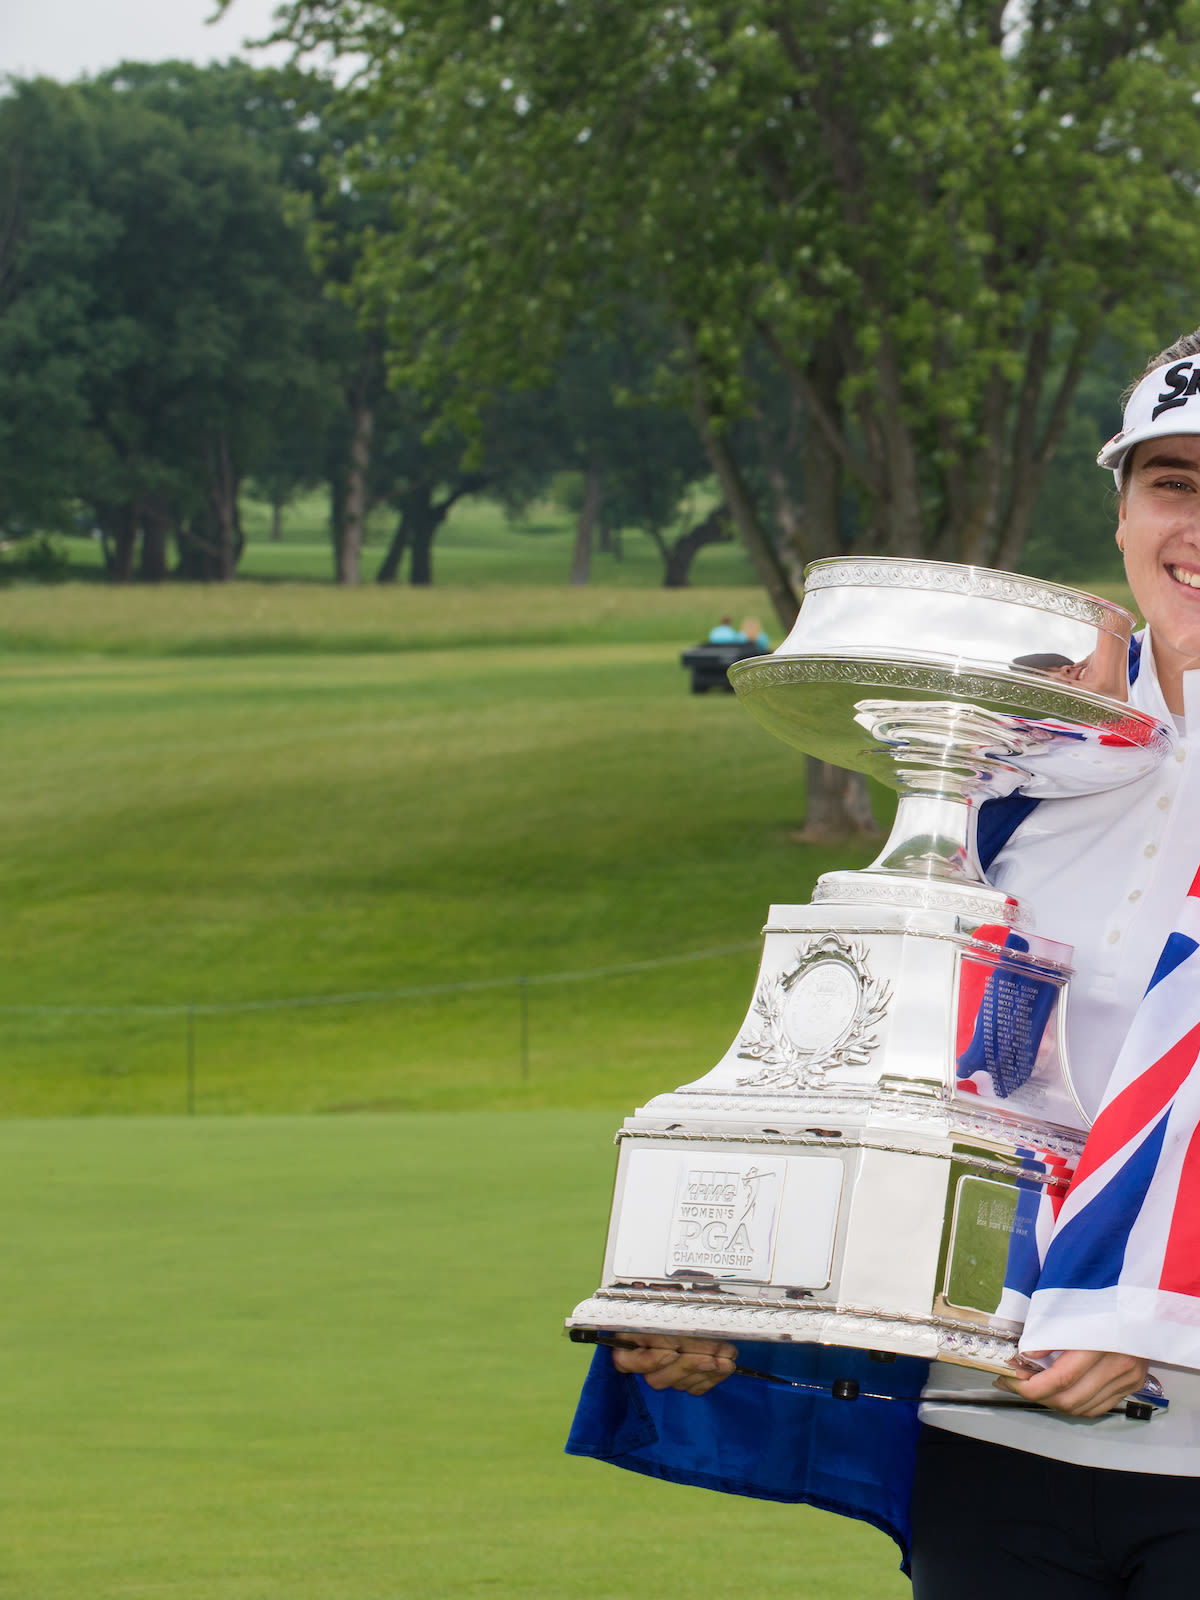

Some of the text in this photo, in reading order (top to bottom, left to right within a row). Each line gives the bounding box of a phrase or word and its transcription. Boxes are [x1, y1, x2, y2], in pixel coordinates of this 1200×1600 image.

[687, 1183, 736, 1202] KPMG
[681, 1206, 735, 1219] WOMEN'S
[674, 1219, 755, 1252] PGA
[673, 1251, 754, 1266] CHAMPIONSHIP
